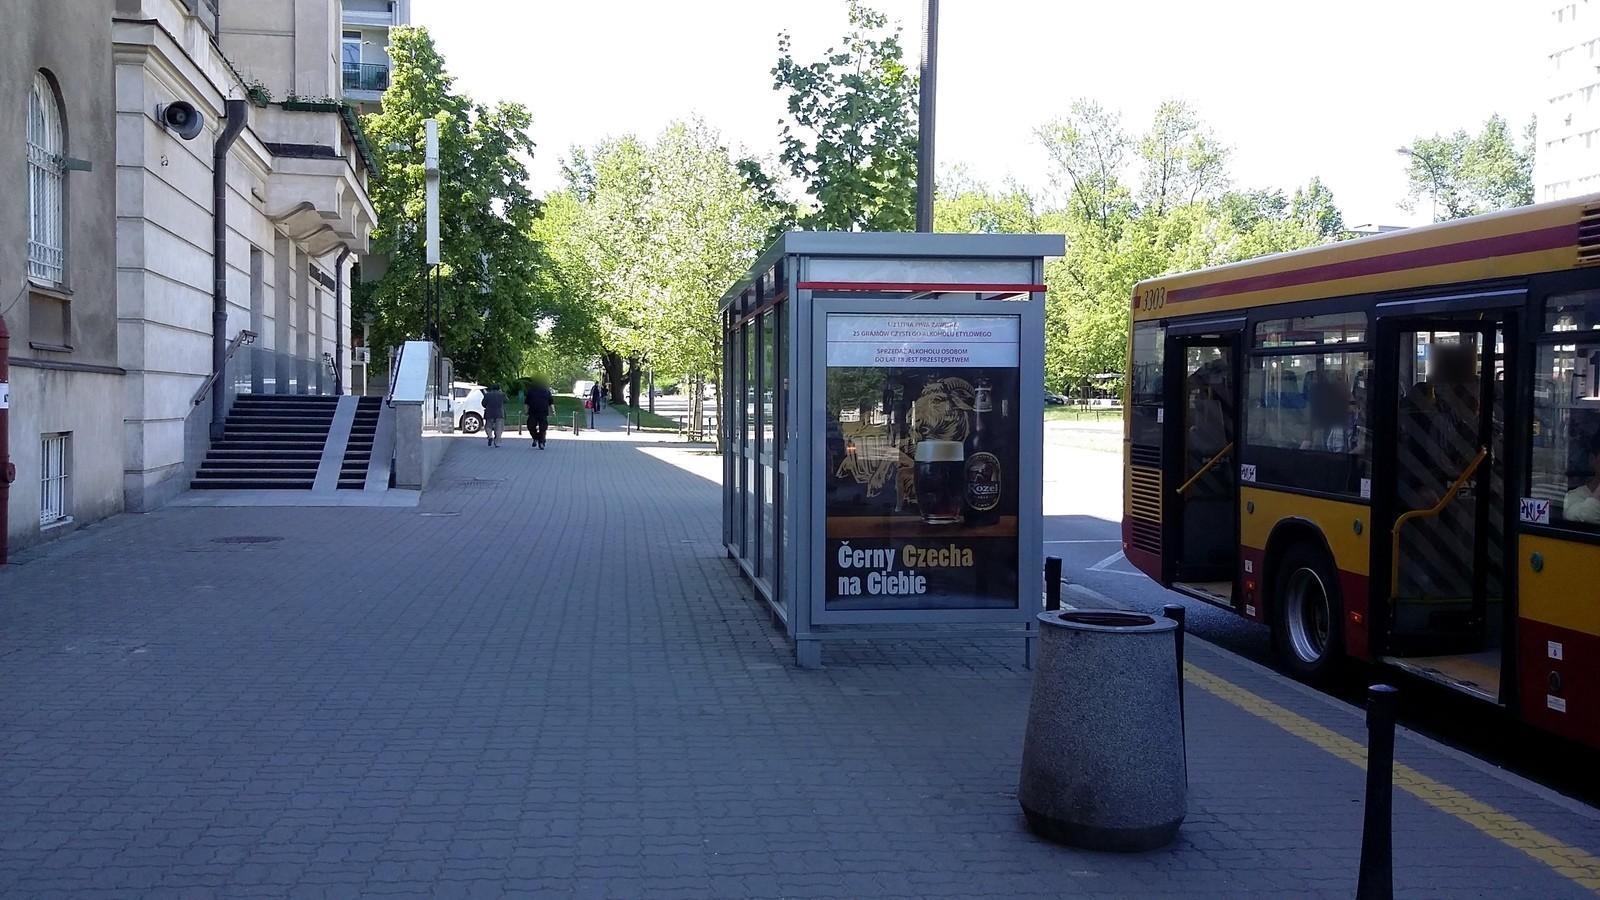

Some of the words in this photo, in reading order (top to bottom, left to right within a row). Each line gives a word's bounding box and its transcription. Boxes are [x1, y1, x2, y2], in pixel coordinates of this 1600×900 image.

[1143, 287, 1165, 311] 3303
[860, 328, 889, 337] GRAMÓW
[919, 356, 970, 364] PRZESTĘPSTWEM
[838, 540, 895, 572] Černy
[902, 543, 974, 568] Czecha
[838, 575, 862, 595] na
[867, 570, 927, 595] Ciebie
